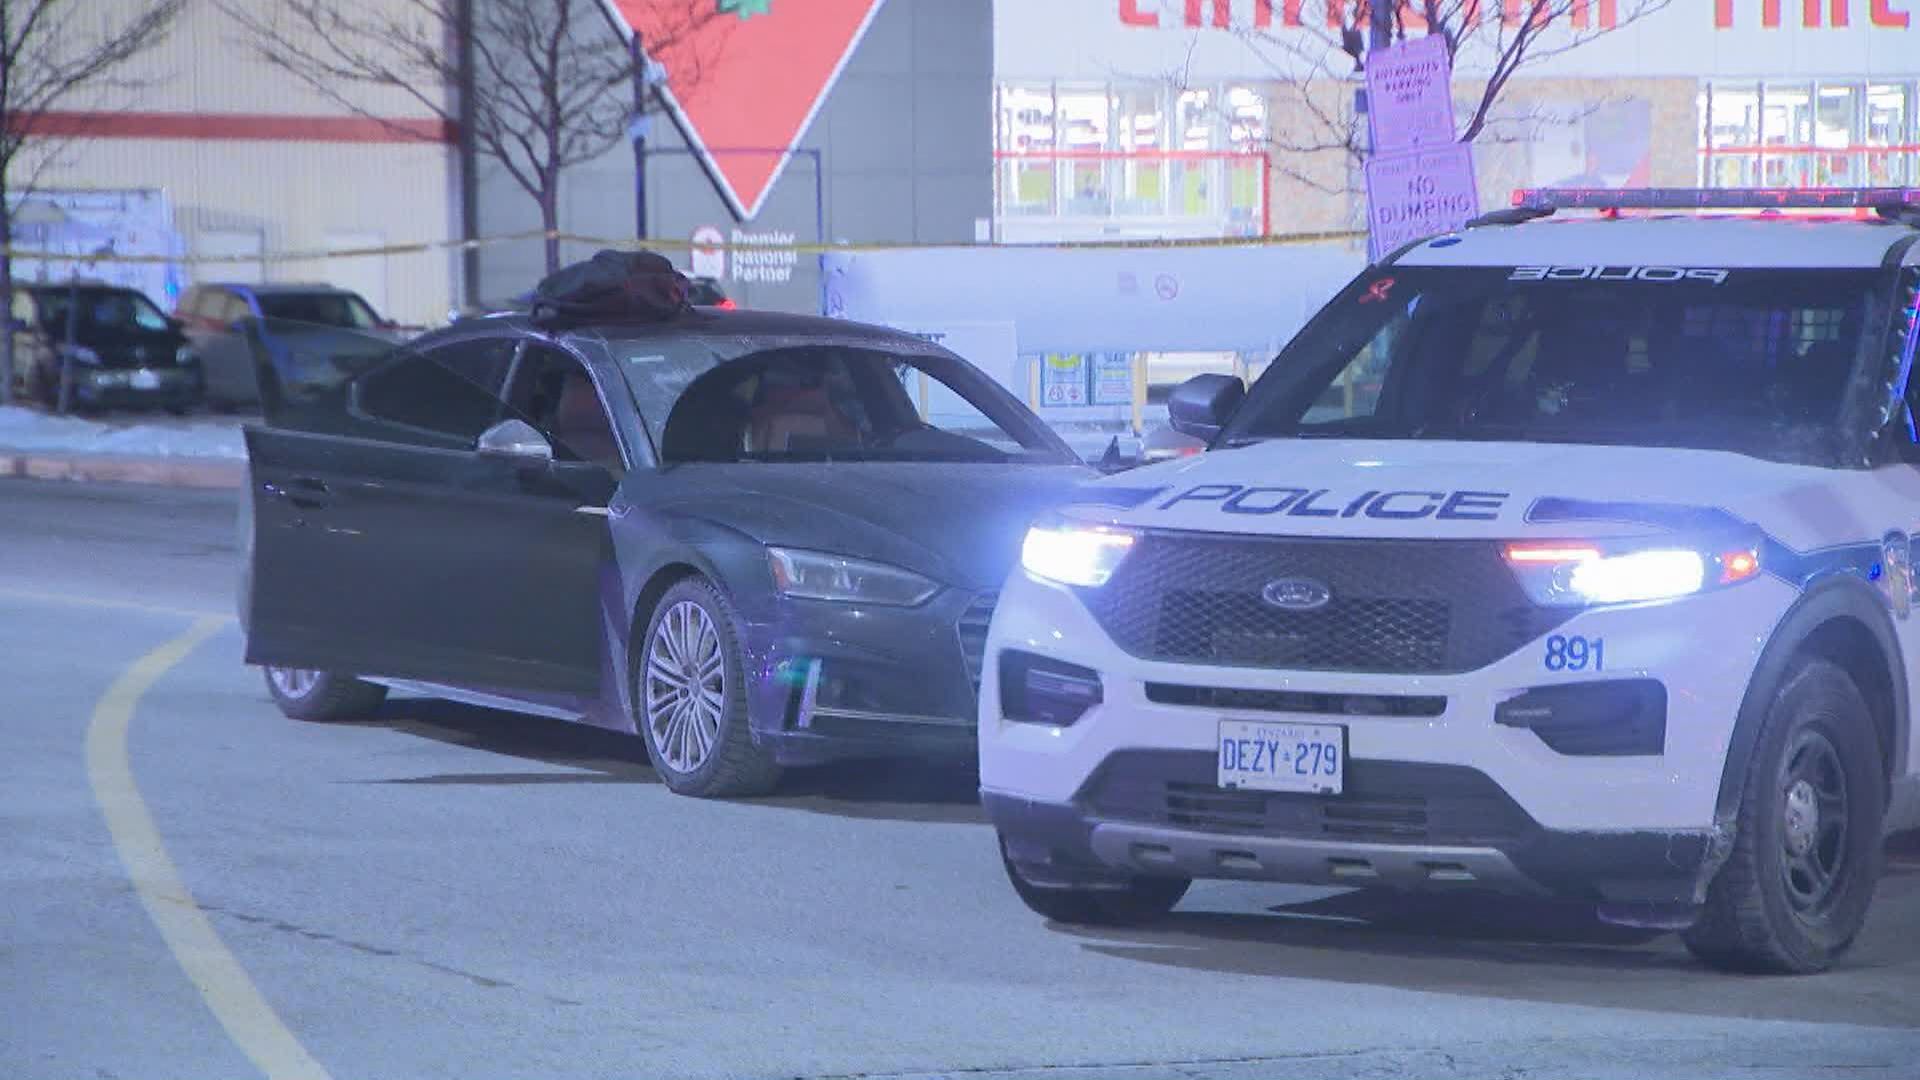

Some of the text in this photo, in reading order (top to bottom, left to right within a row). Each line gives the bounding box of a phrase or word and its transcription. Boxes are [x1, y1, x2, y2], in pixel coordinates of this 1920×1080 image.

[1408, 175, 1434, 197] NO
[1379, 195, 1470, 224] DUMPING
[731, 229, 795, 245] Premier
[732, 248, 797, 265] National
[732, 265, 792, 281] Partner
[1157, 484, 1510, 520] POLICE
[1545, 635, 1603, 671] 891
[1222, 738, 1337, 776] DEZY 279
